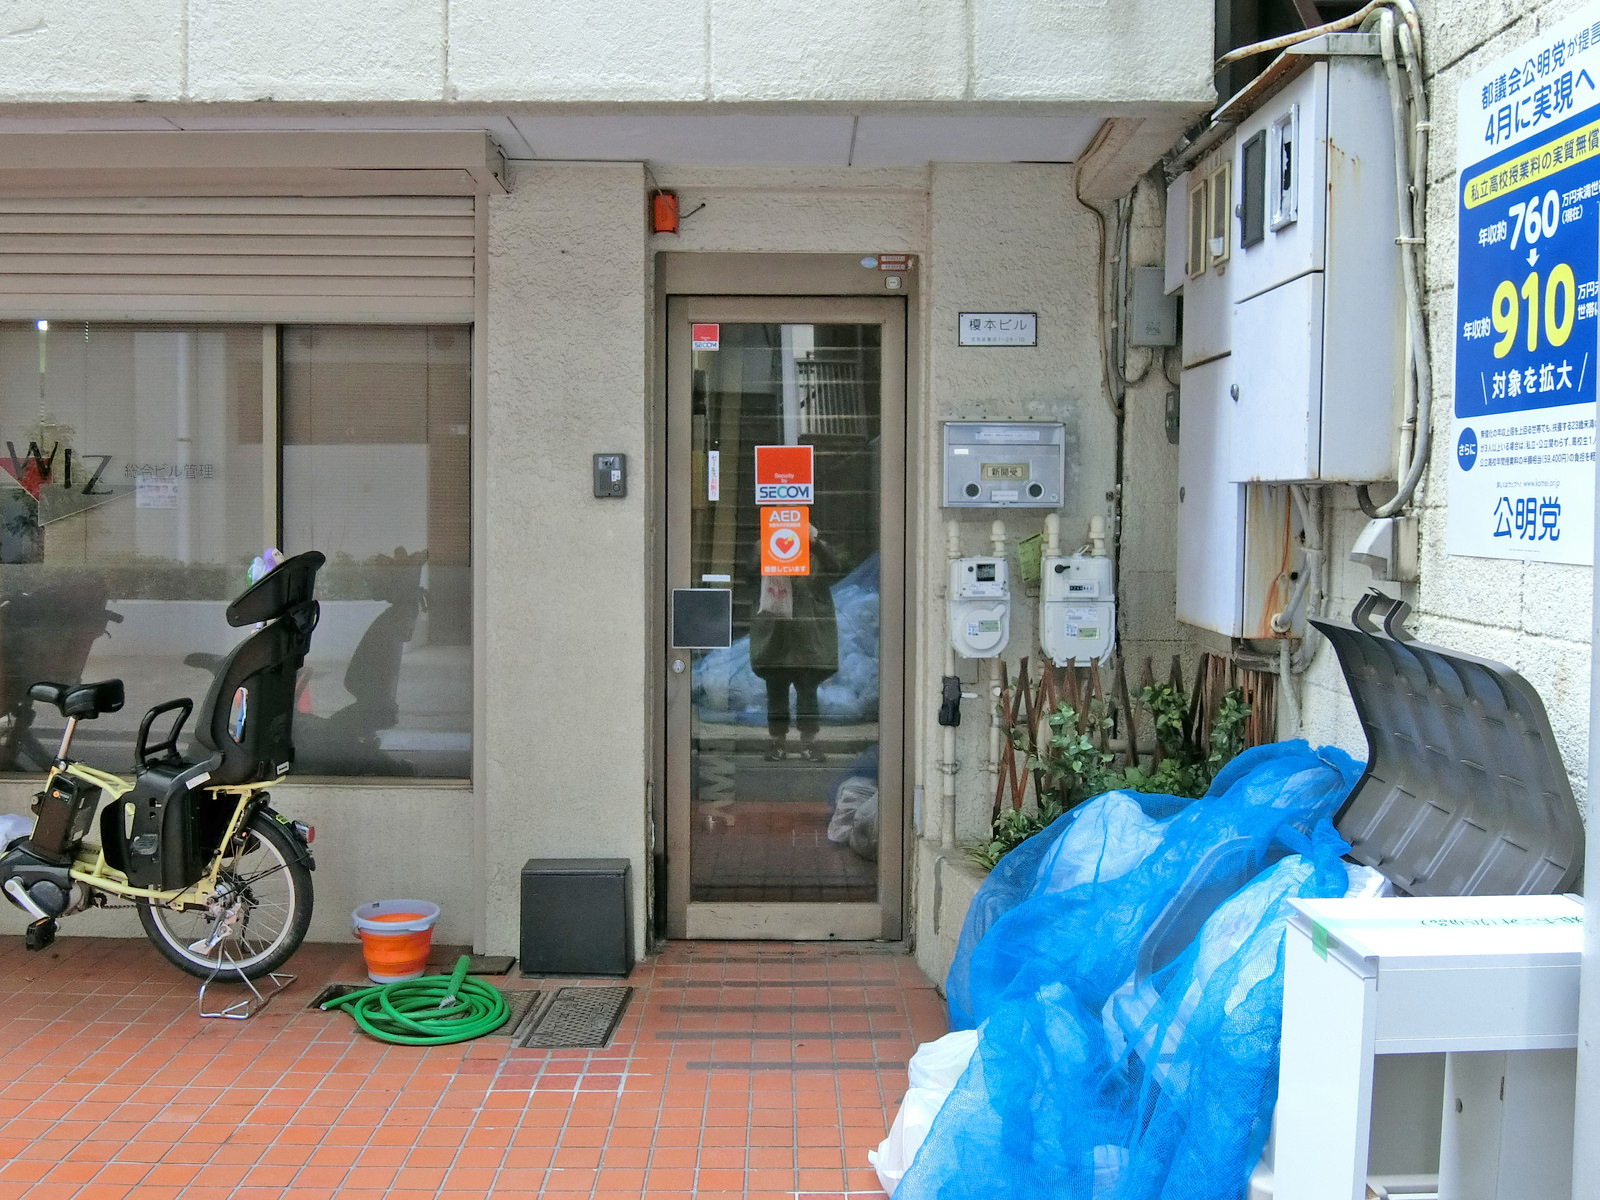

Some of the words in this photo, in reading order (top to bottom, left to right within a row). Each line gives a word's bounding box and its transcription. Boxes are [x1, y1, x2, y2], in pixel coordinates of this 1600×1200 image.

[1485, 69, 1595, 145] 4月に実現へ
[1470, 128, 1600, 202] 私立高校授業料の実質無償
[1478, 220, 1507, 247] 年収約
[1509, 190, 1559, 250] 760
[1562, 179, 1600, 207] 万円未満世
[969, 318, 1027, 331] 榎本ビル
[1463, 317, 1491, 340] 年収約
[1492, 263, 1576, 359] 910
[1492, 360, 1573, 399] 対象を拡大
[1480, 419, 1597, 438] 無償化の年収上限を上回る世帯でも、扶養する23歳未満
[7, 441, 113, 495] WIZ
[1459, 443, 1476, 456] さらに
[124, 463, 213, 479] 総合ビル管理
[760, 486, 809, 498] SECOM
[769, 510, 801, 522] AED
[1493, 496, 1561, 541] 公明党
